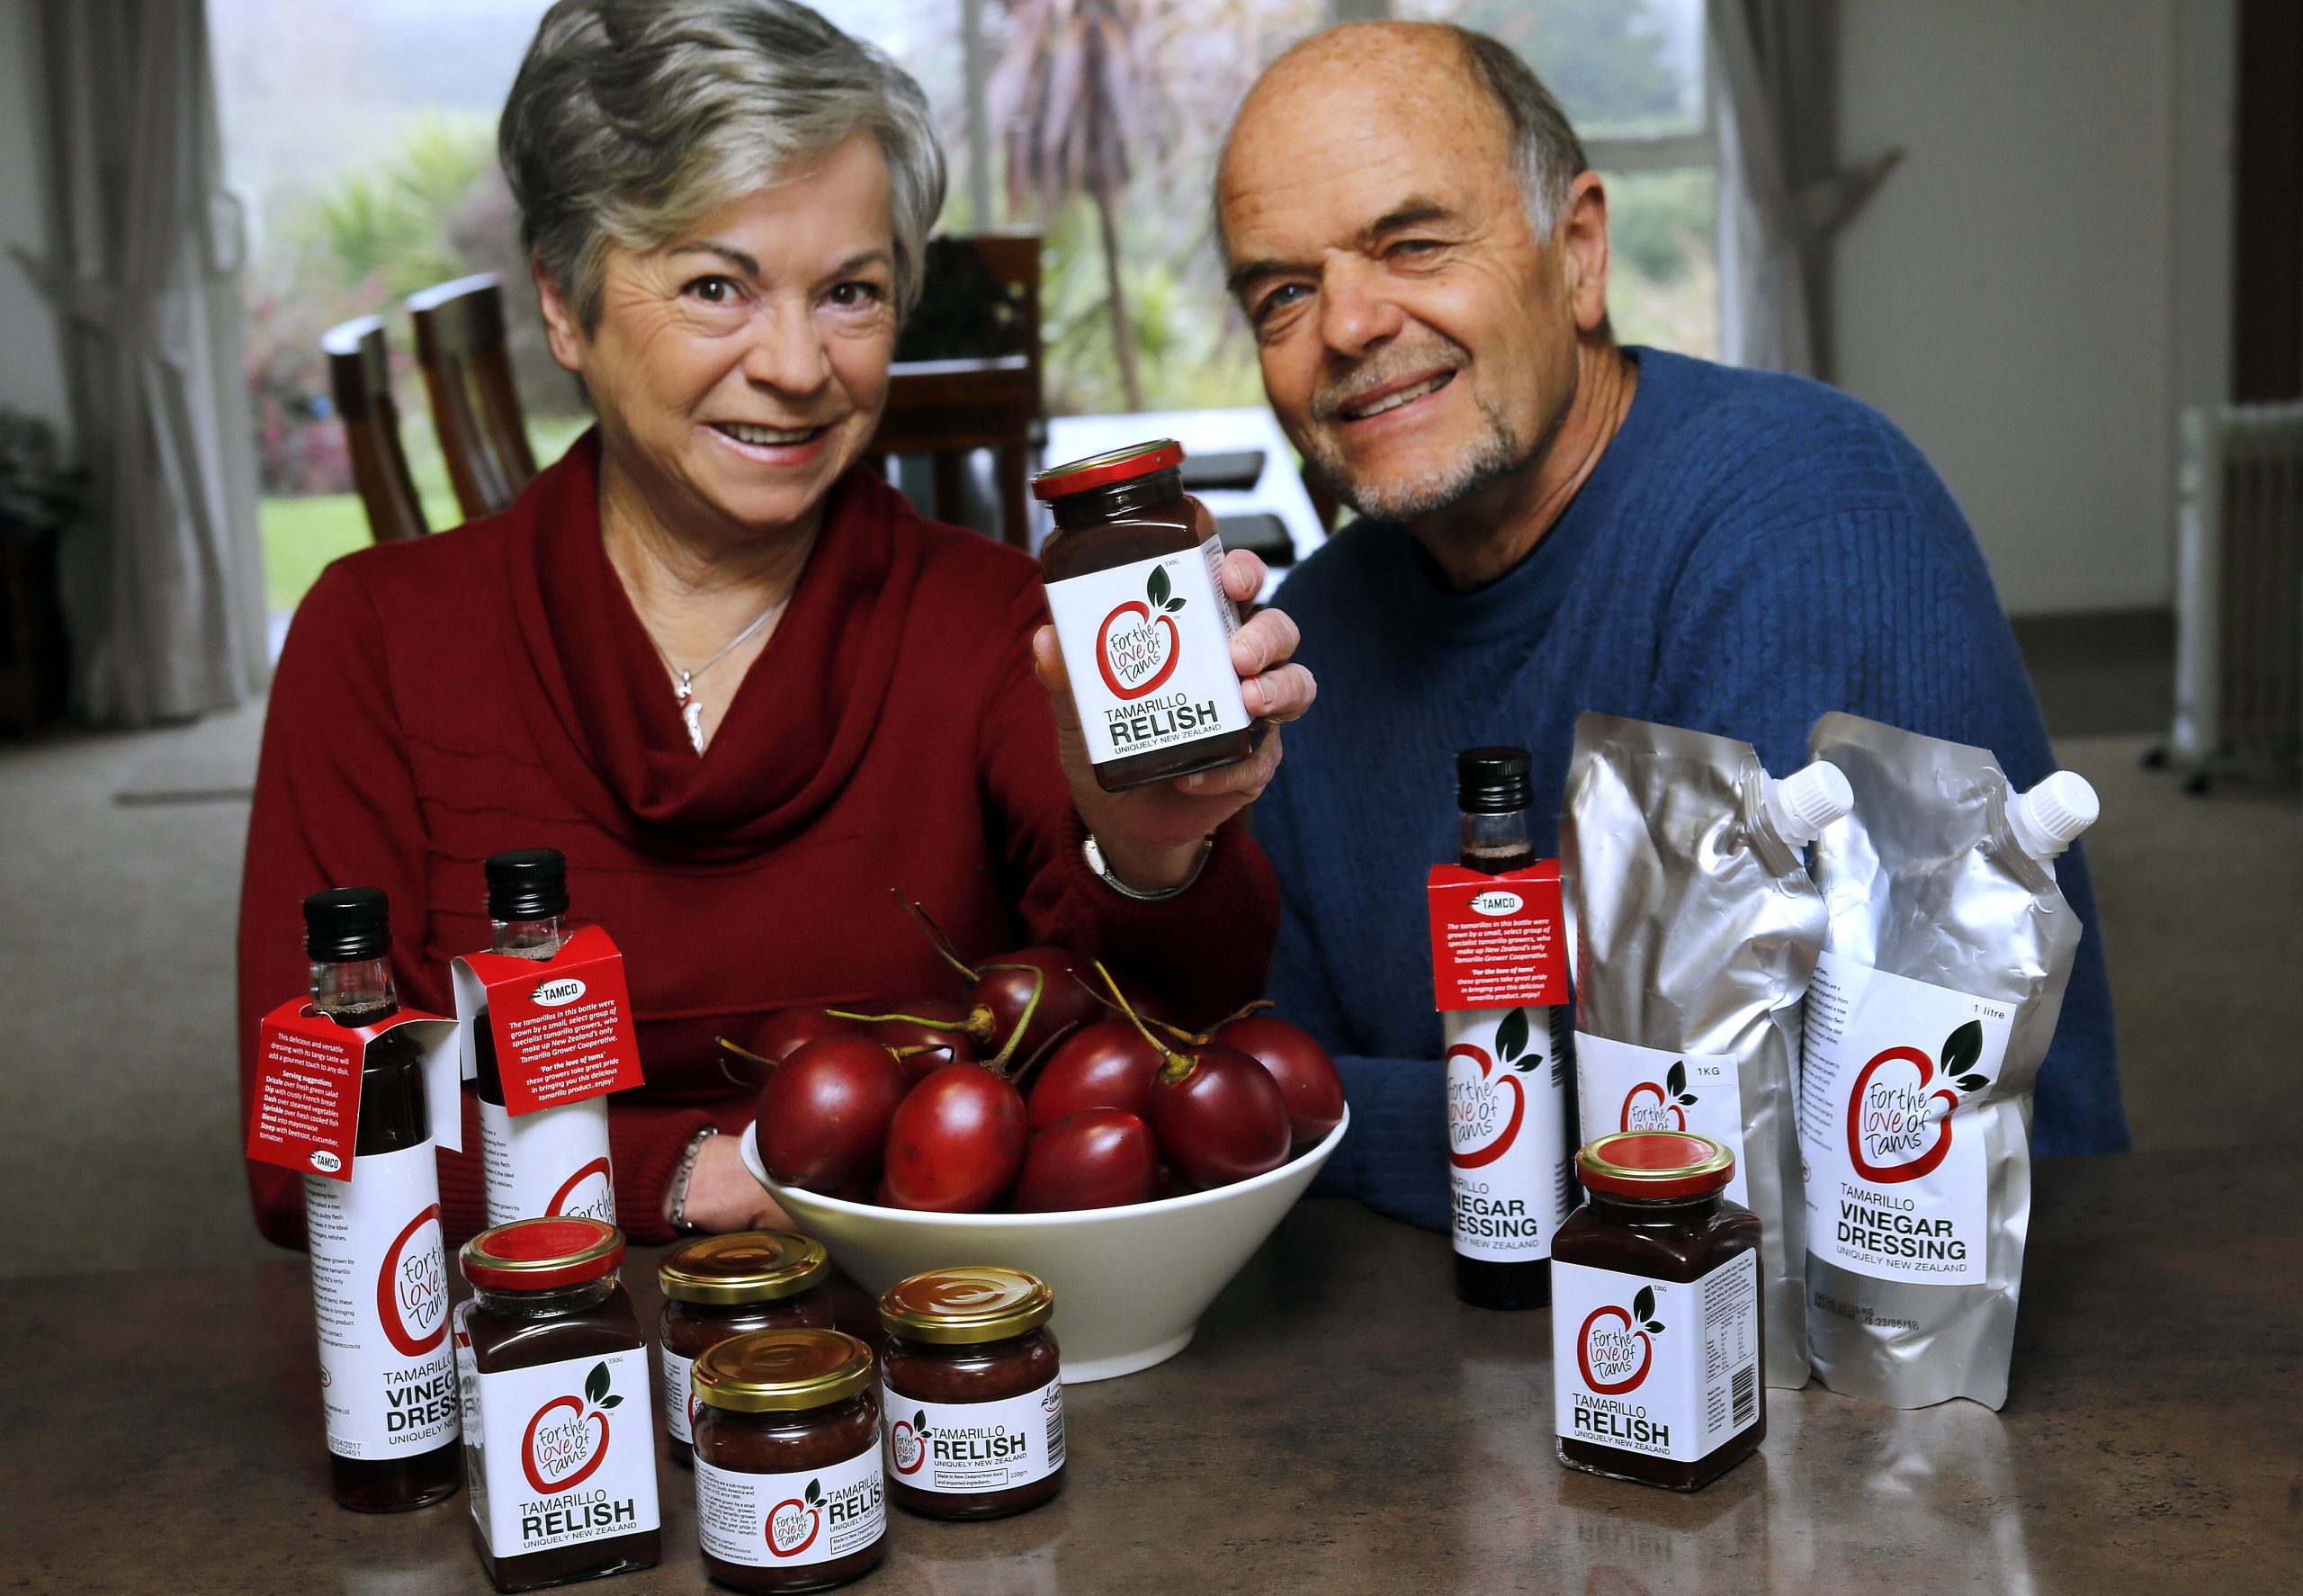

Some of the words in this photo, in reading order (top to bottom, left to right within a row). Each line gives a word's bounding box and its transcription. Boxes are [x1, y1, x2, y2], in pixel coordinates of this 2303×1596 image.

[1110, 632, 1131, 652] For
[1133, 623, 1153, 643] the
[1111, 644, 1144, 669] love
[1147, 633, 1160, 654] of
[1120, 651, 1160, 683] Tams
[1104, 693, 1187, 722] TAMARILLO
[1109, 700, 1218, 746] RELISH
[1116, 739, 1158, 754] UNIQUELY
[1160, 734, 1179, 743] NEW
[1183, 723, 1221, 739] ZEALAND
[1483, 898, 1514, 909] TAMCO
[543, 983, 578, 1000] TAMCO
[511, 1029, 532, 1039] grown
[548, 1019, 567, 1029] small,
[569, 1015, 587, 1024] select
[589, 1009, 608, 1020] group
[610, 1007, 617, 1015] of
[524, 1015, 556, 1026] tamarillos
[578, 1003, 597, 1012] bottle
[598, 1000, 614, 1008] were
[1974, 1004, 1978, 1012] 1
[1984, 1007, 2005, 1019] litre
[513, 1036, 542, 1047] specialist
[543, 1027, 573, 1039] tamarillo
[574, 1022, 602, 1033] growers,
[523, 1045, 540, 1054] make
[551, 1038, 566, 1047] New
[568, 1030, 598, 1043] Zealand's
[599, 1027, 613, 1036] only
[520, 1052, 551, 1063] Tamarillo
[552, 1045, 576, 1056] Grower
[578, 1036, 617, 1049] Cooperative.
[566, 1058, 579, 1066] love
[283, 1071, 301, 1081] Serving
[302, 1076, 332, 1087] suggestions
[539, 1080, 564, 1092] bringing
[591, 1068, 617, 1079] delicious
[544, 1071, 569, 1082] growers
[586, 1063, 602, 1071] great
[604, 1058, 619, 1068] pride
[1698, 1066, 1720, 1076] 1KG
[539, 1089, 567, 1101] tamarillo
[1465, 1076, 1492, 1101] the
[1871, 1082, 1895, 1108] For
[1897, 1082, 1927, 1111] the
[1479, 1096, 1499, 1120] of
[1632, 1106, 1647, 1123] For
[1648, 1103, 1665, 1123] the
[1864, 1101, 1903, 1133] love
[1907, 1110, 1931, 1133] of
[262, 1113, 277, 1122] Blend
[278, 1116, 287, 1125] into
[289, 1120, 318, 1132] mayonnaise
[260, 1132, 282, 1143] tomatoes
[1865, 1133, 1922, 1159] Tams
[317, 1155, 338, 1169] TAMCO
[1453, 1192, 1524, 1216] NEGAR
[1842, 1182, 1914, 1211] TAMARILLO
[1453, 1209, 1537, 1237] RESSING
[1841, 1200, 1952, 1238] VINEGAR
[1470, 1238, 1489, 1247] NEW
[1492, 1240, 1538, 1249] ZEALAND
[1838, 1222, 1966, 1260] DRESSING
[403, 1253, 430, 1283] For
[1837, 1245, 1883, 1265] UNIQUELY
[1886, 1260, 1911, 1269] NEW
[1915, 1262, 1967, 1272] ZEALAND
[400, 1269, 440, 1309] love
[1593, 1330, 1610, 1347] For
[1613, 1329, 1632, 1348] the
[1591, 1342, 1620, 1362] love
[1622, 1344, 1635, 1359] of
[383, 1352, 452, 1385] TAMARILLO
[1594, 1360, 1632, 1378] Tams
[386, 1369, 453, 1407] VINEG
[387, 1390, 457, 1431] DRESS
[1573, 1394, 1645, 1419] TAMARILLO
[389, 1425, 442, 1445] UNIQUELY
[539, 1427, 561, 1446] For
[563, 1418, 585, 1438] the
[932, 1425, 1004, 1439] TAMARILLO
[1575, 1407, 1669, 1447] RELISH
[537, 1439, 572, 1464] love
[576, 1429, 590, 1449] of
[934, 1432, 1026, 1460] RELISH
[1574, 1430, 1613, 1443] UNIQUELY
[1615, 1439, 1633, 1447] NEW
[1635, 1442, 1670, 1455] ZEALAND
[543, 1447, 587, 1477] Tams
[935, 1460, 972, 1468] UNIQUELY
[995, 1453, 1026, 1466] ZEALAND
[827, 1470, 878, 1503] TAMARILLO
[520, 1490, 606, 1516] TAMARILLO
[522, 1498, 635, 1540] RELISH
[775, 1517, 790, 1528] For
[791, 1512, 804, 1524] the
[775, 1525, 796, 1538] love
[798, 1520, 807, 1531] of
[830, 1516, 863, 1532] UNIQUELY
[865, 1511, 874, 1519] NEW
[524, 1535, 570, 1548] UNIQUELY
[572, 1530, 593, 1539] NEW
[596, 1522, 637, 1535] ZEALAND
[778, 1530, 805, 1547] Tams
